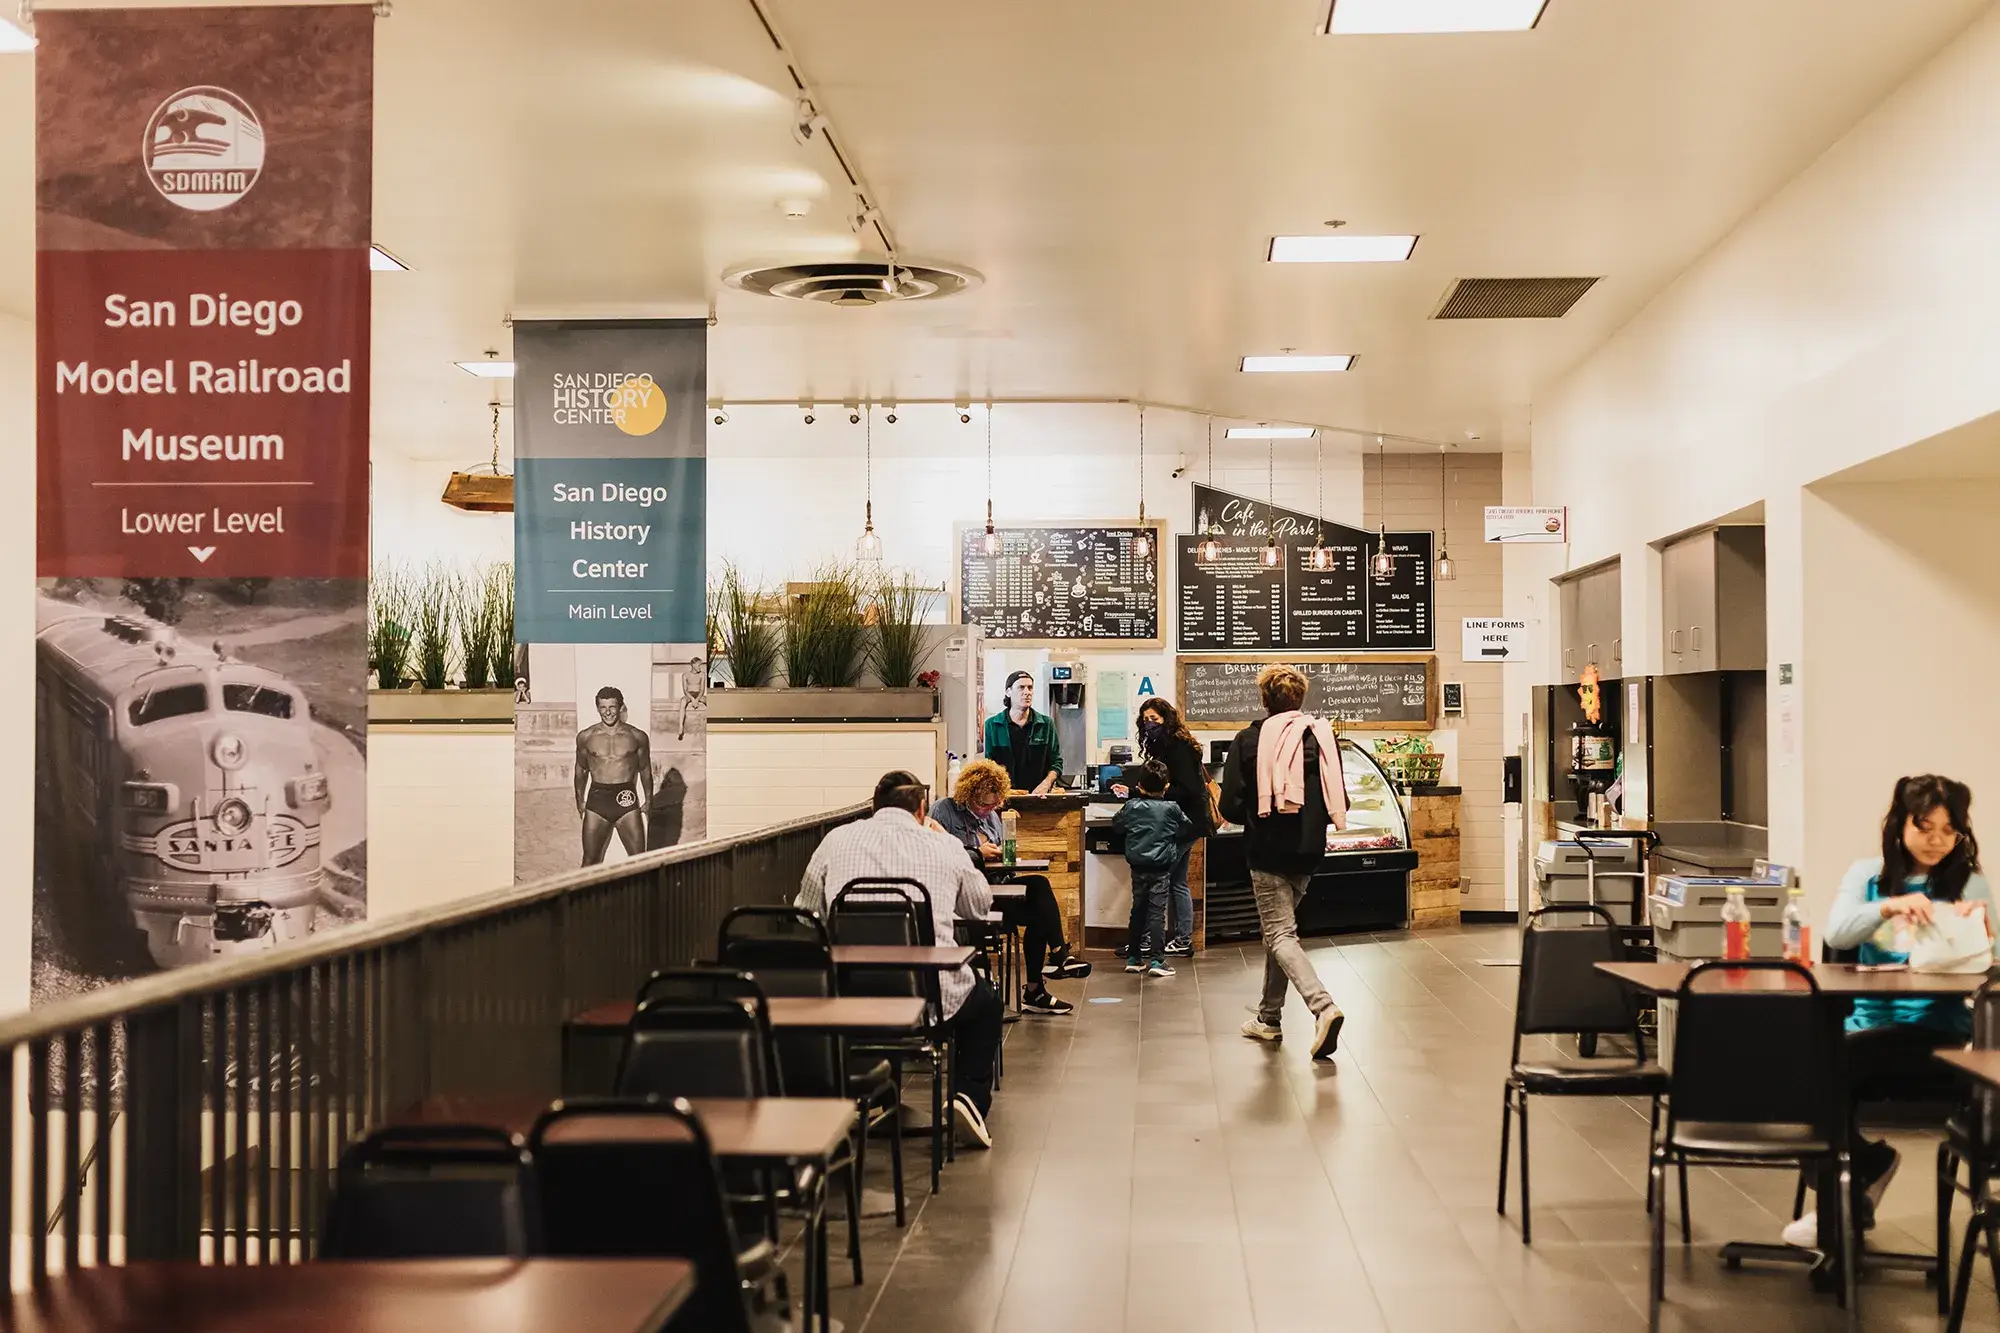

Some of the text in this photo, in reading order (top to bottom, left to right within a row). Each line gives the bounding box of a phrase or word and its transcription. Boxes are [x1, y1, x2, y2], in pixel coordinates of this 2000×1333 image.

[162, 172, 246, 191] SDMRM
[104, 293, 303, 336] San Diego
[56, 359, 351, 394] Model Railroad
[553, 373, 653, 388] SAN DIEGO
[553, 389, 652, 408] HISTORY
[553, 409, 626, 424] CENTER
[122, 428, 285, 461] Museum
[553, 483, 667, 507] San Diego
[121, 507, 285, 534] Lower Level
[1221, 499, 1254, 525] Cafe
[570, 521, 650, 546] History
[1232, 516, 1315, 538] in the Park
[572, 558, 649, 578] Center
[569, 604, 652, 619] Main Level
[1335, 664, 1347, 673] AM
[1138, 677, 1155, 695] A
[169, 839, 252, 852] SANTA
